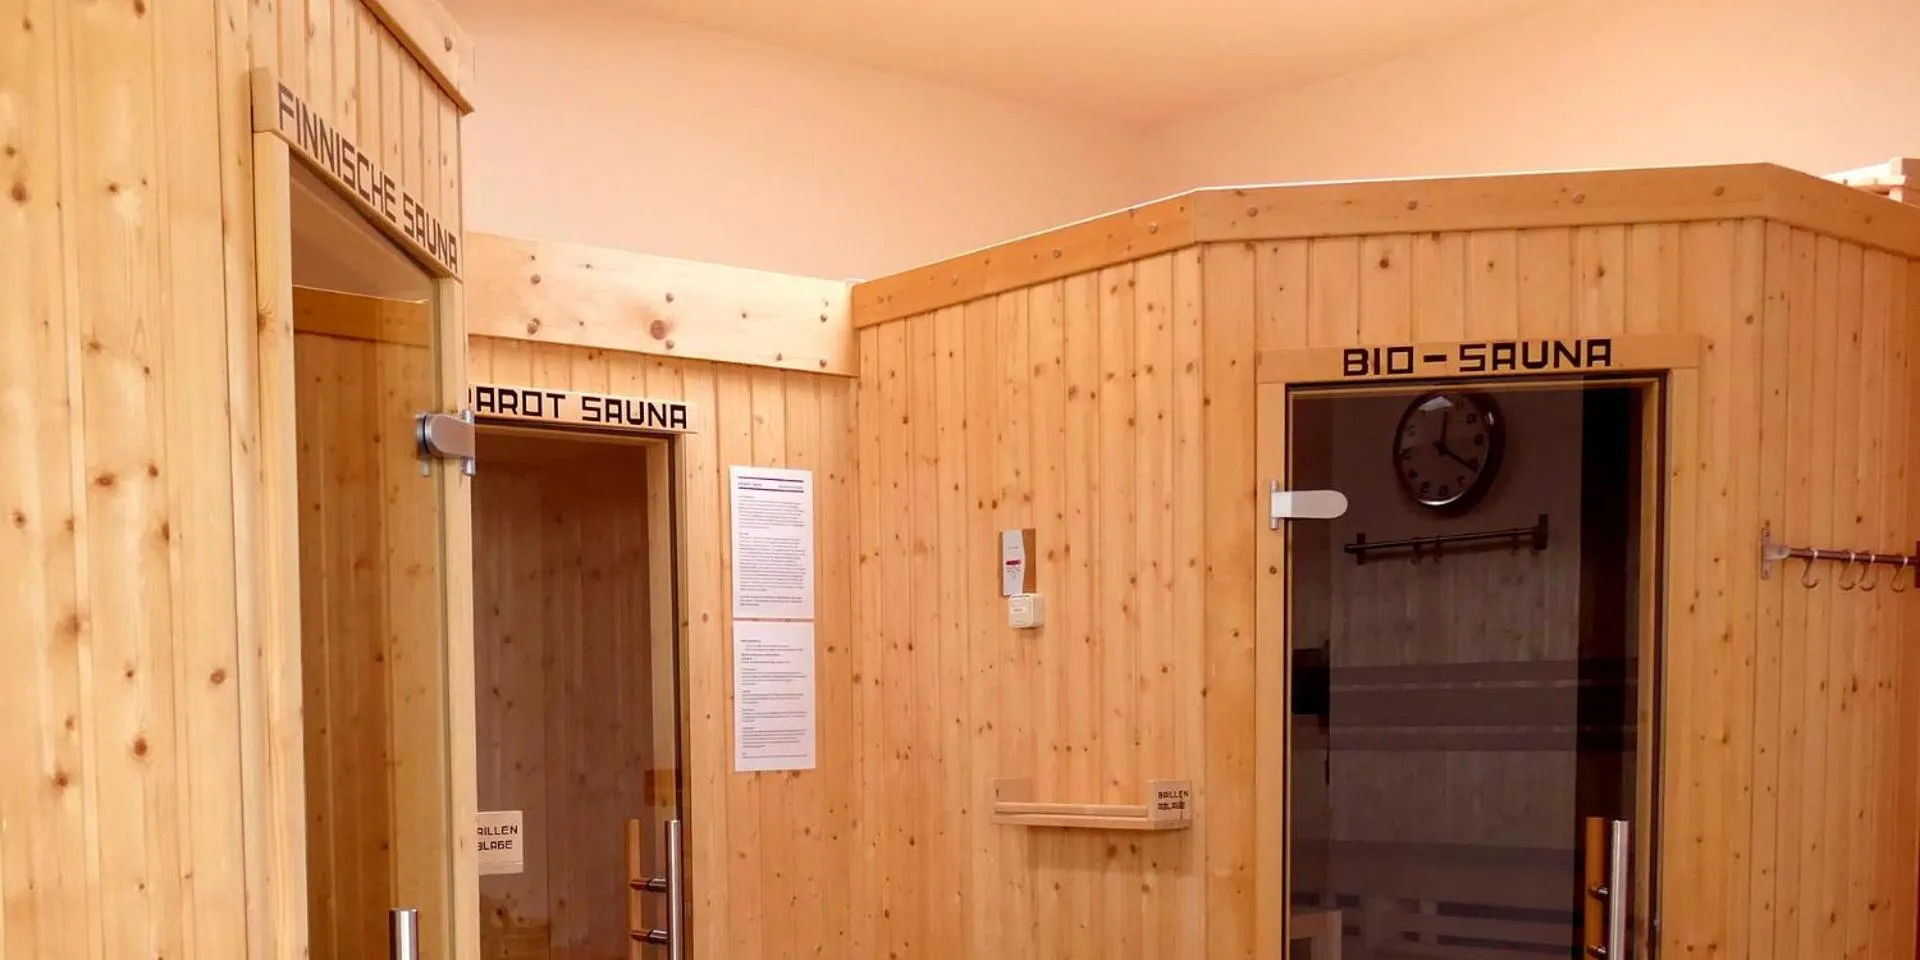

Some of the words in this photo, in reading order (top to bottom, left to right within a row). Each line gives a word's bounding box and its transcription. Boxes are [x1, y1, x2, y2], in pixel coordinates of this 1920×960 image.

[278, 81, 397, 223] FINNISCHE
[402, 192, 458, 274] SAUNA
[468, 386, 566, 418] AROT
[582, 396, 687, 429] SAUNA
[477, 825, 518, 836] RILLEN
[477, 840, 512, 851] BLAGE
